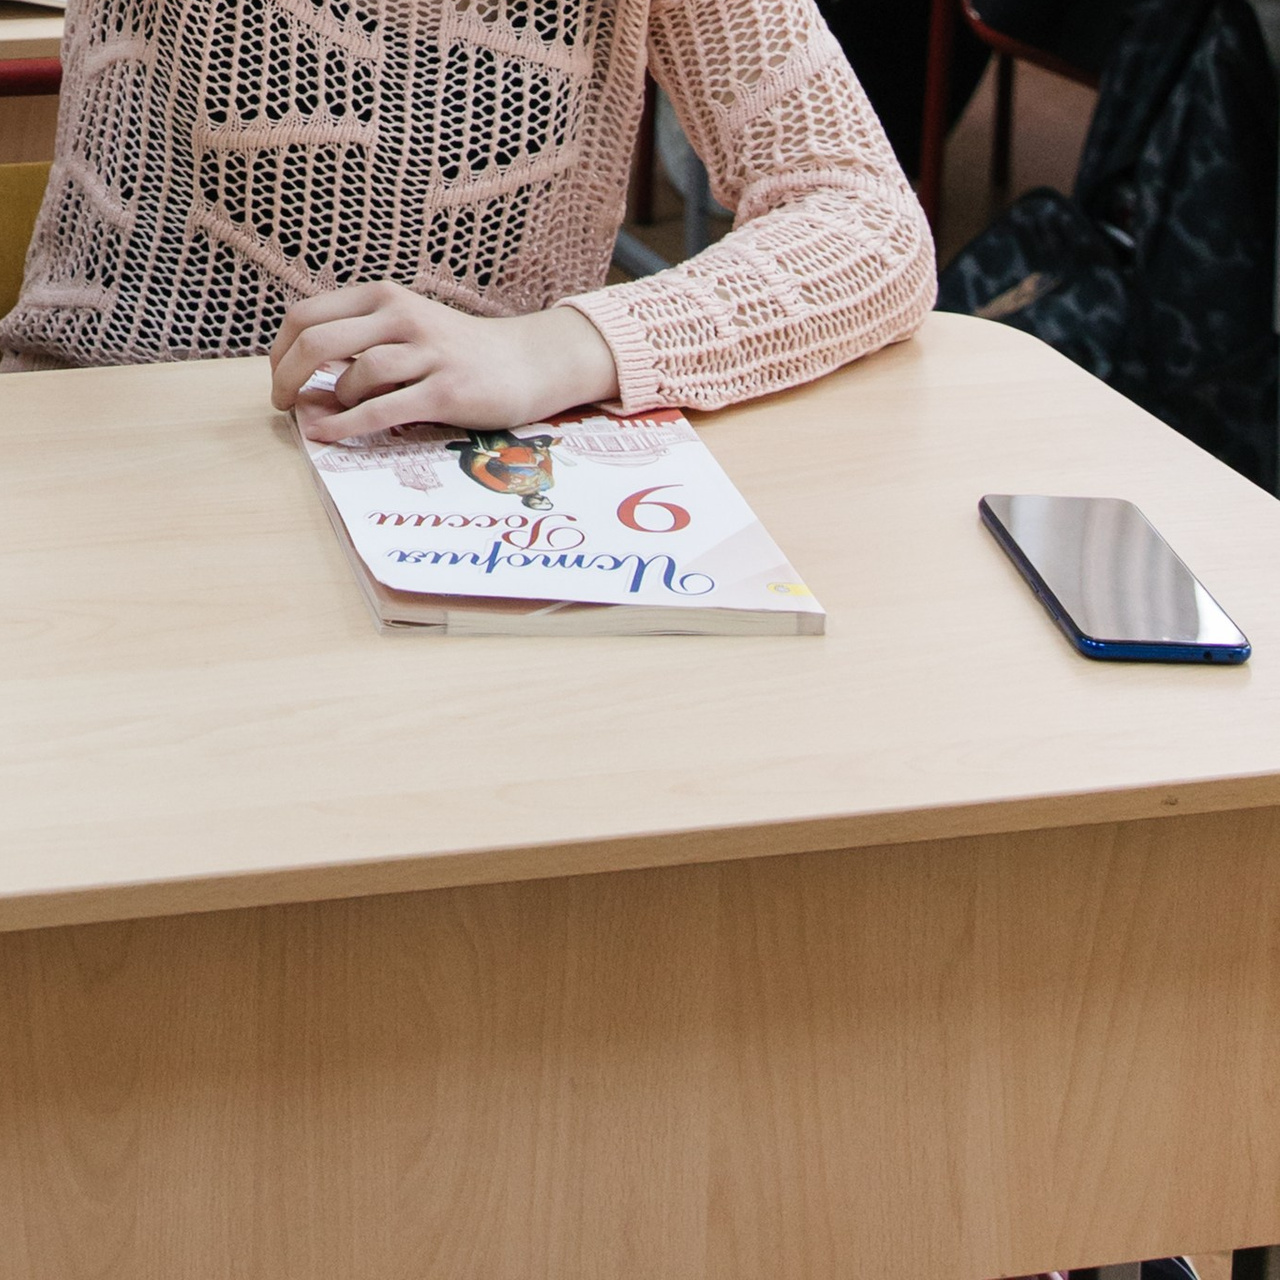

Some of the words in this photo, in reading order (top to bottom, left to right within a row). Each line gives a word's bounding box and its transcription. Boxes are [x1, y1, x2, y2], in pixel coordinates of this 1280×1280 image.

[368, 511, 586, 551] России
[617, 484, 692, 532] 9
[387, 541, 715, 595] История
